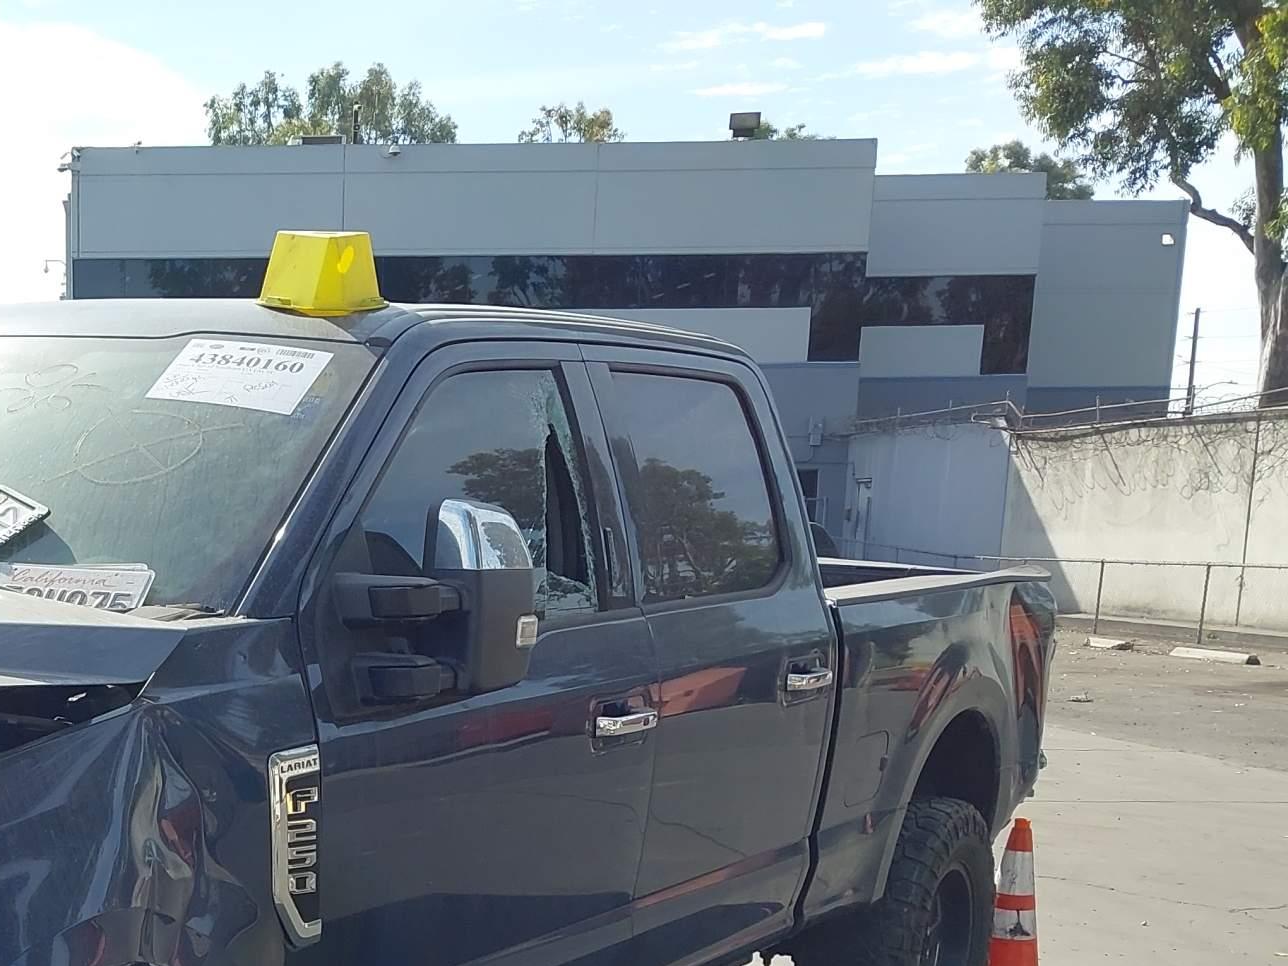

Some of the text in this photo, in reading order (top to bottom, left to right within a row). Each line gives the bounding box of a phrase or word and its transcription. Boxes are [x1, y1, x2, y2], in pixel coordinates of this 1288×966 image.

[189, 352, 305, 374] 43840160
[10, 568, 116, 589] California
[280, 757, 318, 774] LARIAT
